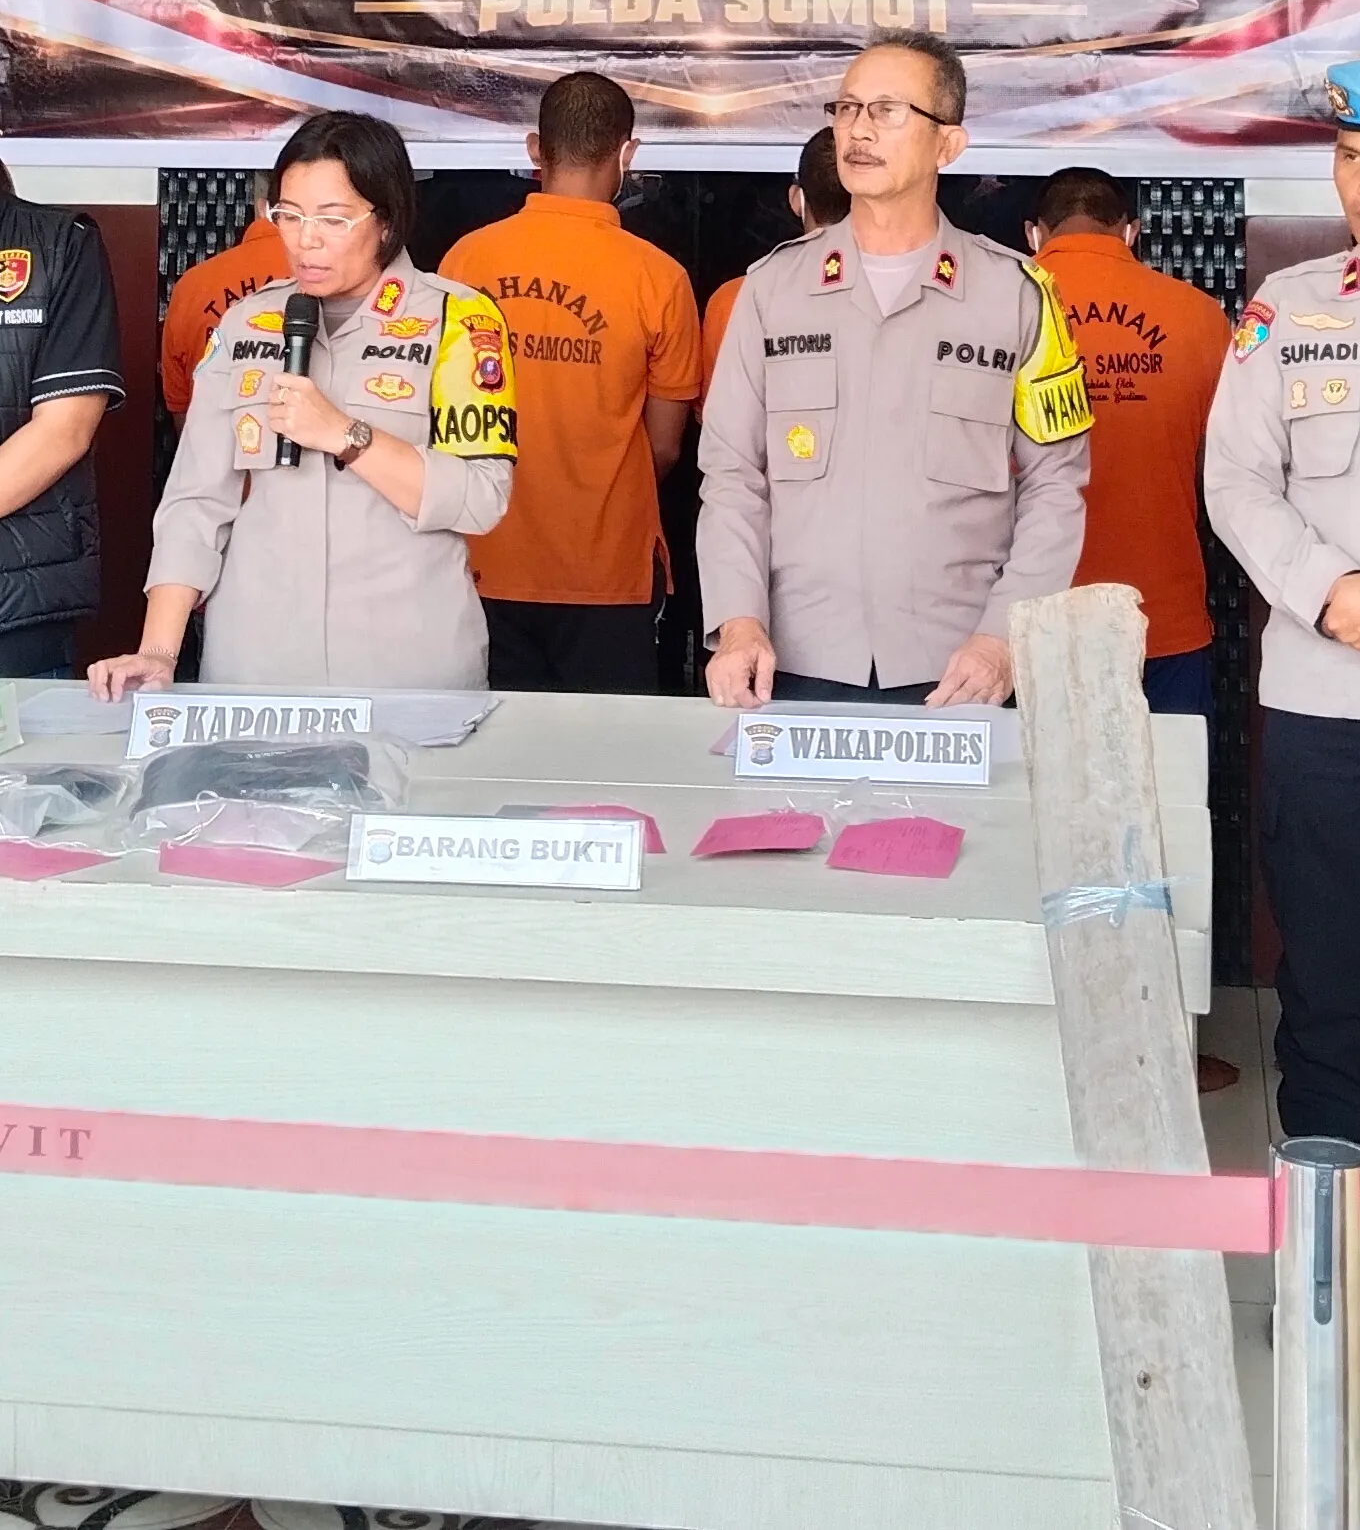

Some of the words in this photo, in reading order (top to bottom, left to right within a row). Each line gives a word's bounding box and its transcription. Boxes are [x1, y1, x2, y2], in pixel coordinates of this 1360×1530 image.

[4, 308, 42, 324] RESKRIM
[361, 343, 432, 366] POLRI
[523, 333, 602, 365] SAMOSIR
[936, 340, 1016, 373] POLRI
[1279, 342, 1358, 365] SUHADI
[1095, 352, 1164, 375] SAMOSIR
[789, 726, 983, 766] WAKAPOLRES
[395, 835, 521, 860] BARANG
[530, 839, 623, 863] BUKTI
